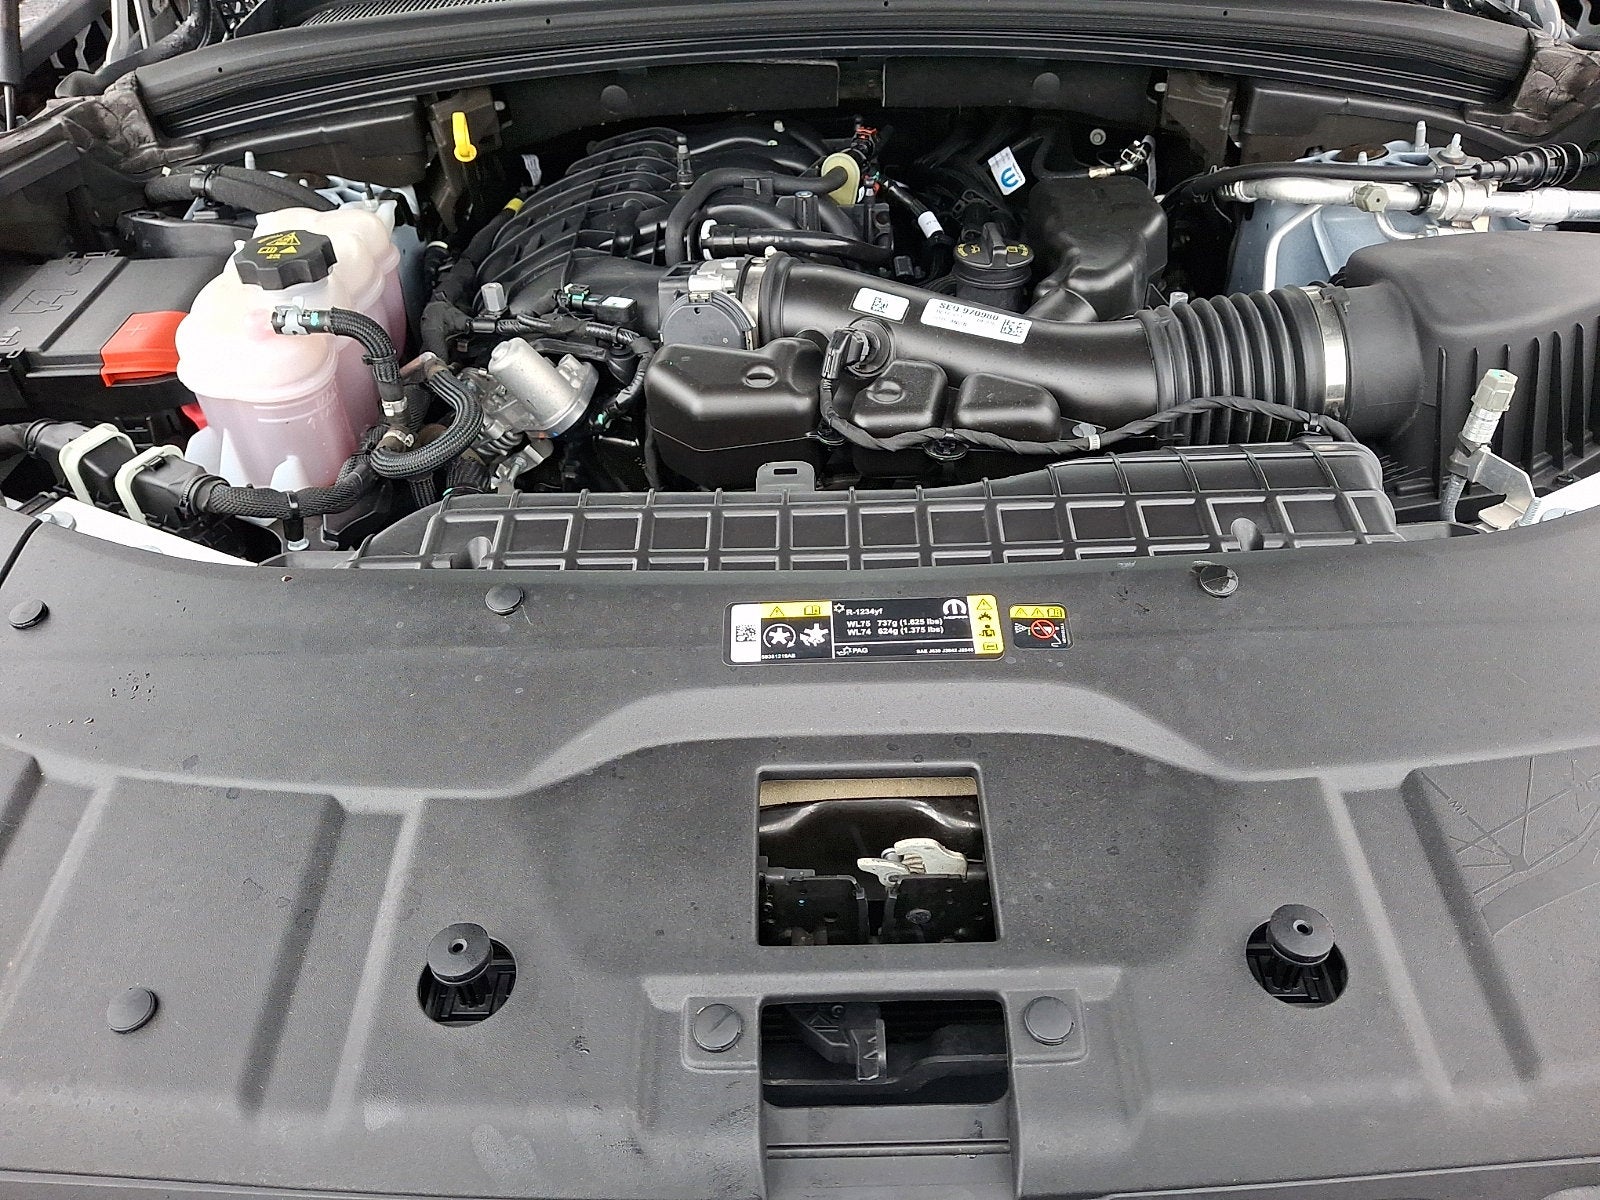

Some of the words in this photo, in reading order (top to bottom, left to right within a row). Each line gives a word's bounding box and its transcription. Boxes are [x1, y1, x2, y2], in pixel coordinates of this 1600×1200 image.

[845, 607, 883, 616] R-1234yf
[847, 620, 871, 628] WL75
[877, 619, 898, 628] 737g
[847, 628, 872, 636] WL74
[877, 627, 898, 636] 624g
[900, 626, 926, 635] (1.375
